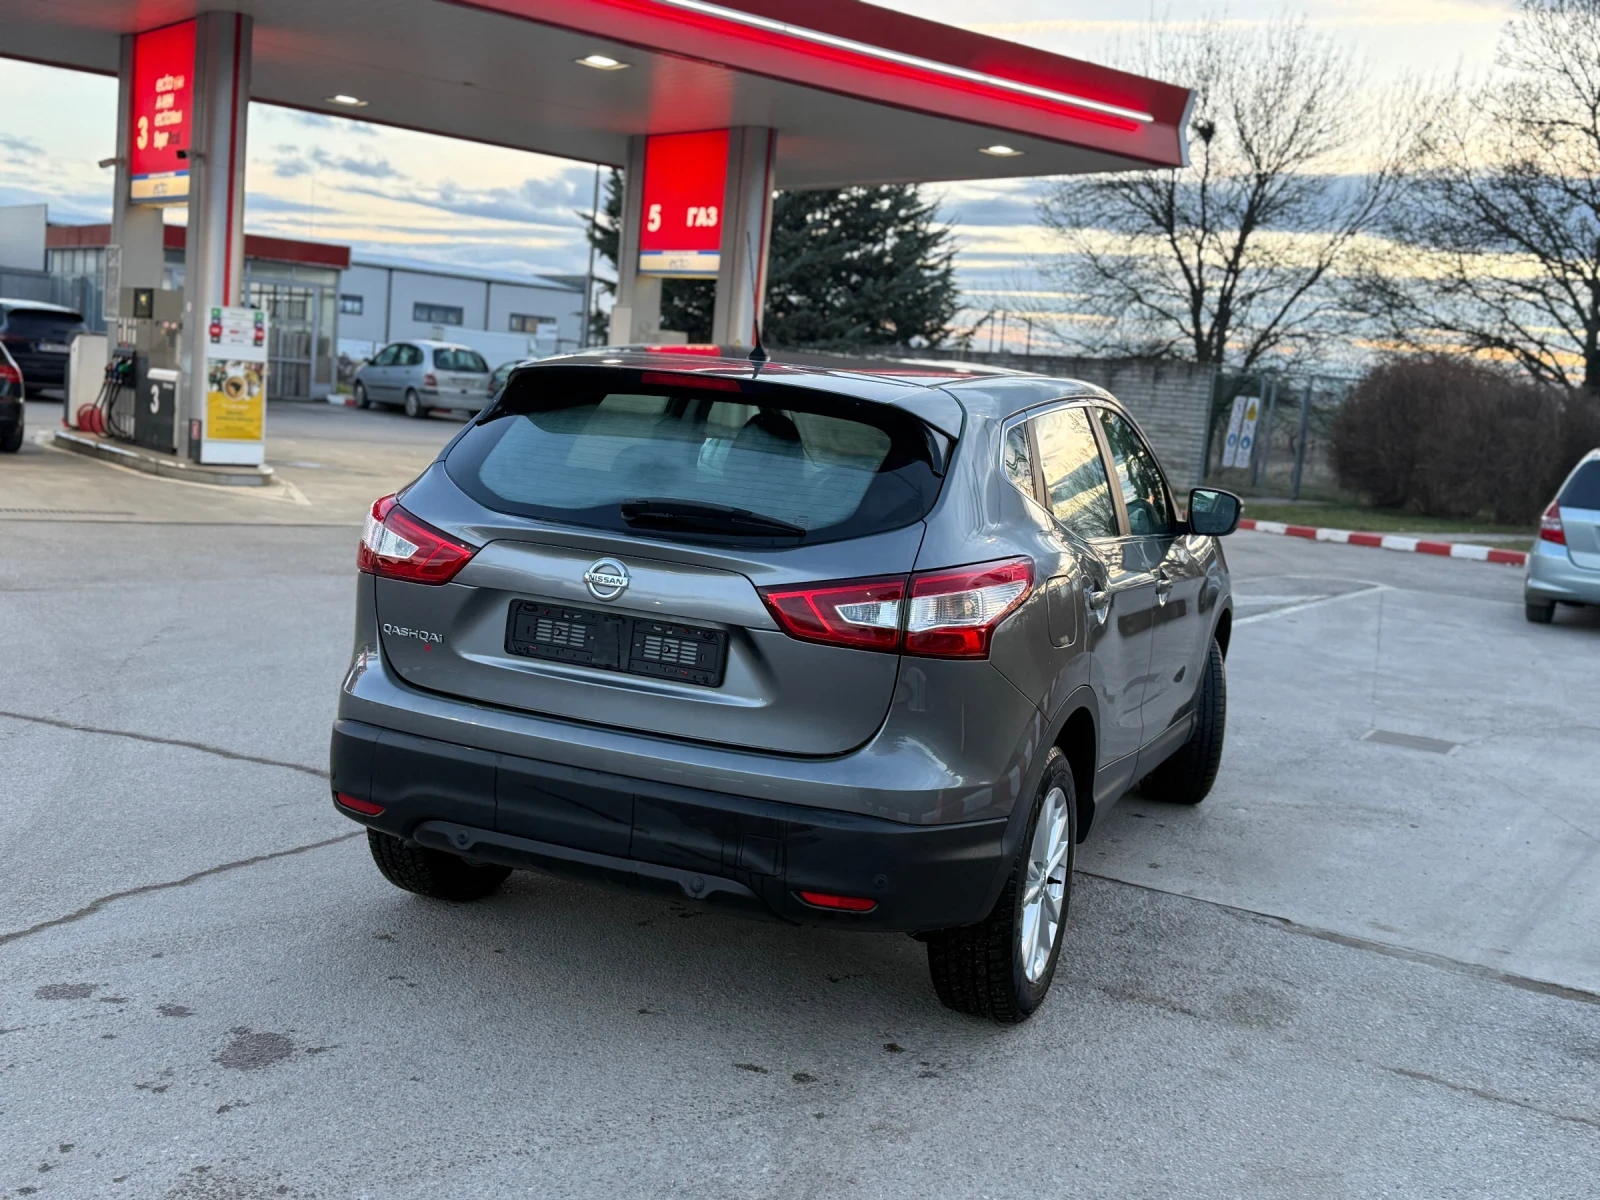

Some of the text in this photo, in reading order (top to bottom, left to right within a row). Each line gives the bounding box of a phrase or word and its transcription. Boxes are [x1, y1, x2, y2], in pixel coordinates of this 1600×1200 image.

[137, 115, 149, 150] 3
[647, 203, 662, 233] 5
[686, 206, 718, 227] ГАЗ
[150, 384, 160, 414] 3
[589, 574, 624, 586] NISSAN
[383, 623, 443, 643] QASHQAI
